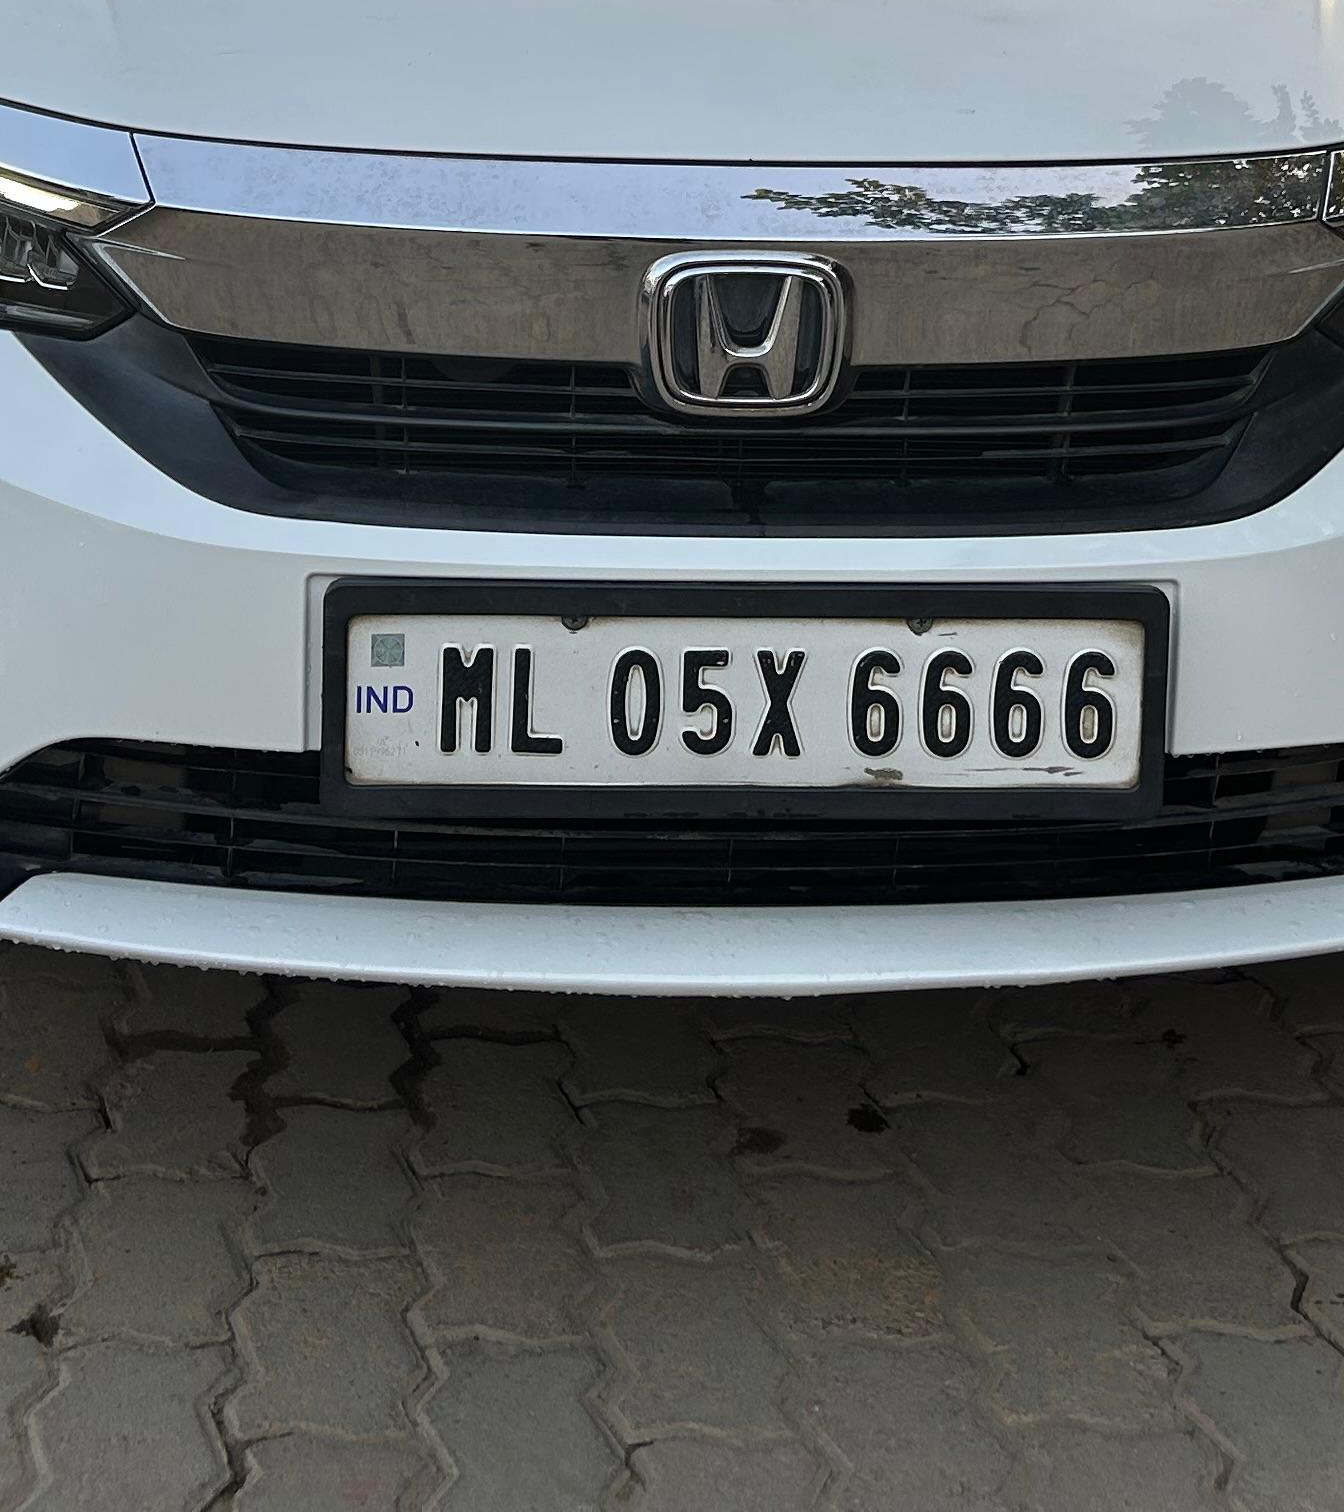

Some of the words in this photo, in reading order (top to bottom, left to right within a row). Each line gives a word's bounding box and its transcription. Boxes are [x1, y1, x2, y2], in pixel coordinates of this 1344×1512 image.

[356, 685, 414, 714] IND
[440, 647, 563, 753] ML
[610, 649, 806, 756] 05X
[851, 650, 1115, 758] 6666
